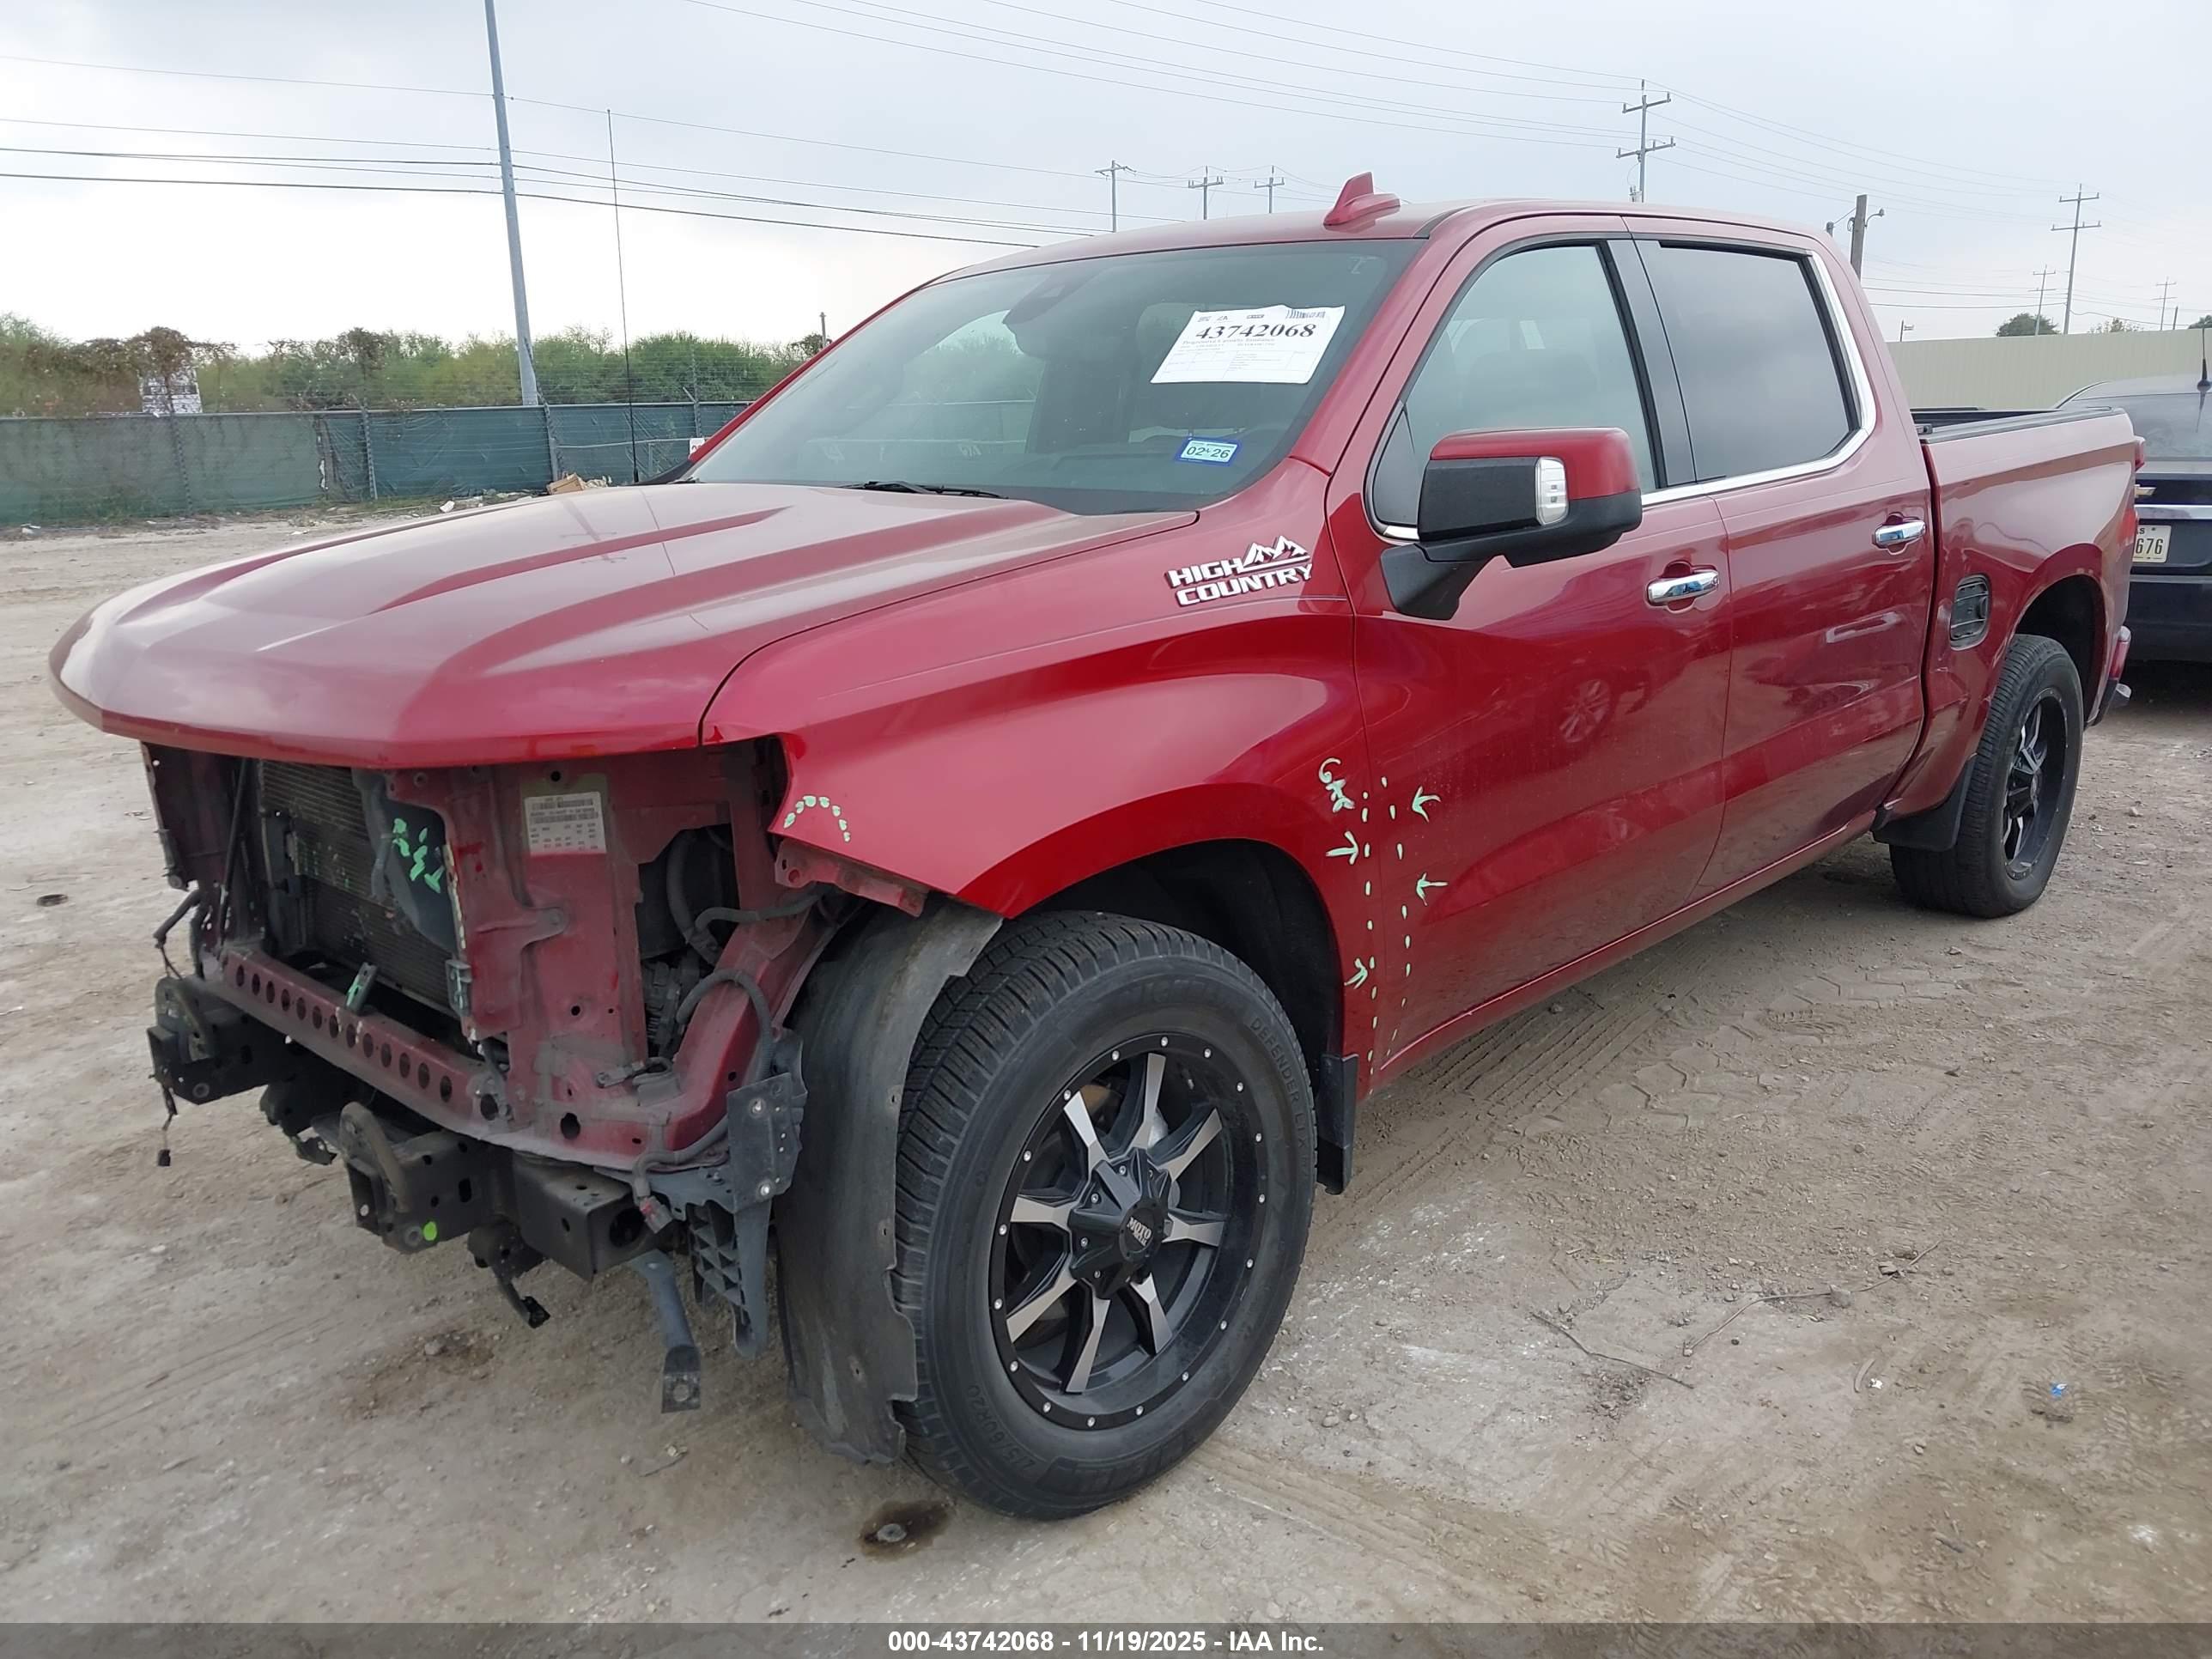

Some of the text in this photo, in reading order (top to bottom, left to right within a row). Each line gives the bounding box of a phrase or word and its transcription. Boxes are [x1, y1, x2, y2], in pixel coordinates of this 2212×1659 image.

[1195, 323, 1317, 339] 43742068
[1186, 446, 1231, 459] 02 26
[2135, 538, 2164, 555] 676
[1165, 557, 1244, 588] HIGH
[1175, 562, 1313, 606] COUNTRY
[1249, 1017, 1301, 1104] DEFENDER
[1126, 1216, 1152, 1240] MOTO
